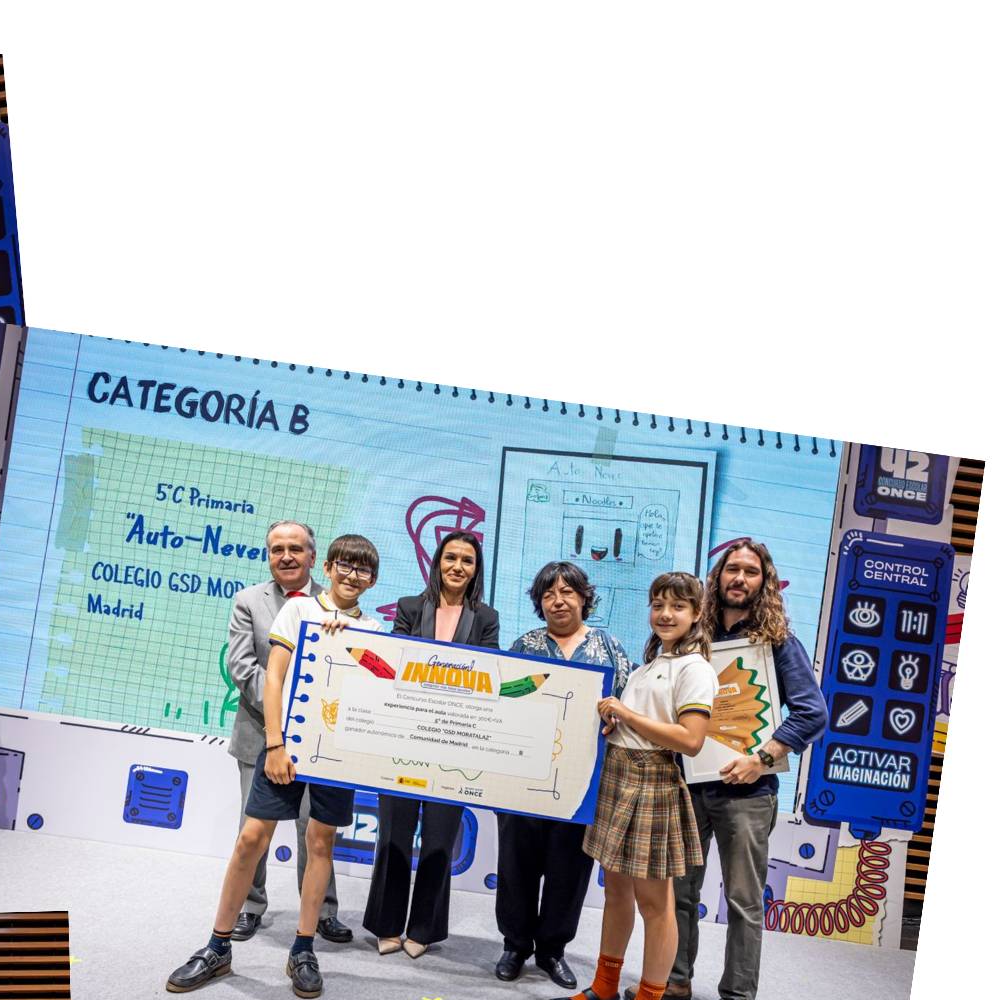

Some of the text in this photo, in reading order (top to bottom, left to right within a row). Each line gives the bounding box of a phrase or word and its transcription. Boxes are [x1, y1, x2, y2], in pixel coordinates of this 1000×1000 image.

[87, 371, 310, 435] CATEGORÍA B
[880, 446, 930, 483] 42
[189, 486, 255, 515] Primaria
[877, 486, 927, 502] ONCE
[91, 561, 201, 594] COLEGIO GSD
[863, 569, 928, 587] CENTRAL
[864, 559, 929, 577] CONTROL
[87, 593, 145, 621] Madrid
[901, 609, 929, 636] 11:11
[401, 660, 493, 694] INNOVA
[384, 701, 415, 712] experiencia
[415, 706, 428, 714] para
[434, 708, 447, 716] aula
[417, 724, 442, 733] COLEGIO
[449, 720, 472, 728] Primaria
[409, 733, 441, 743] Comunidad
[449, 739, 468, 748] Madrid
[830, 746, 912, 772] ACTIVAR
[828, 763, 911, 790] IMAGINACIÓN
[464, 789, 483, 798] ONCE
